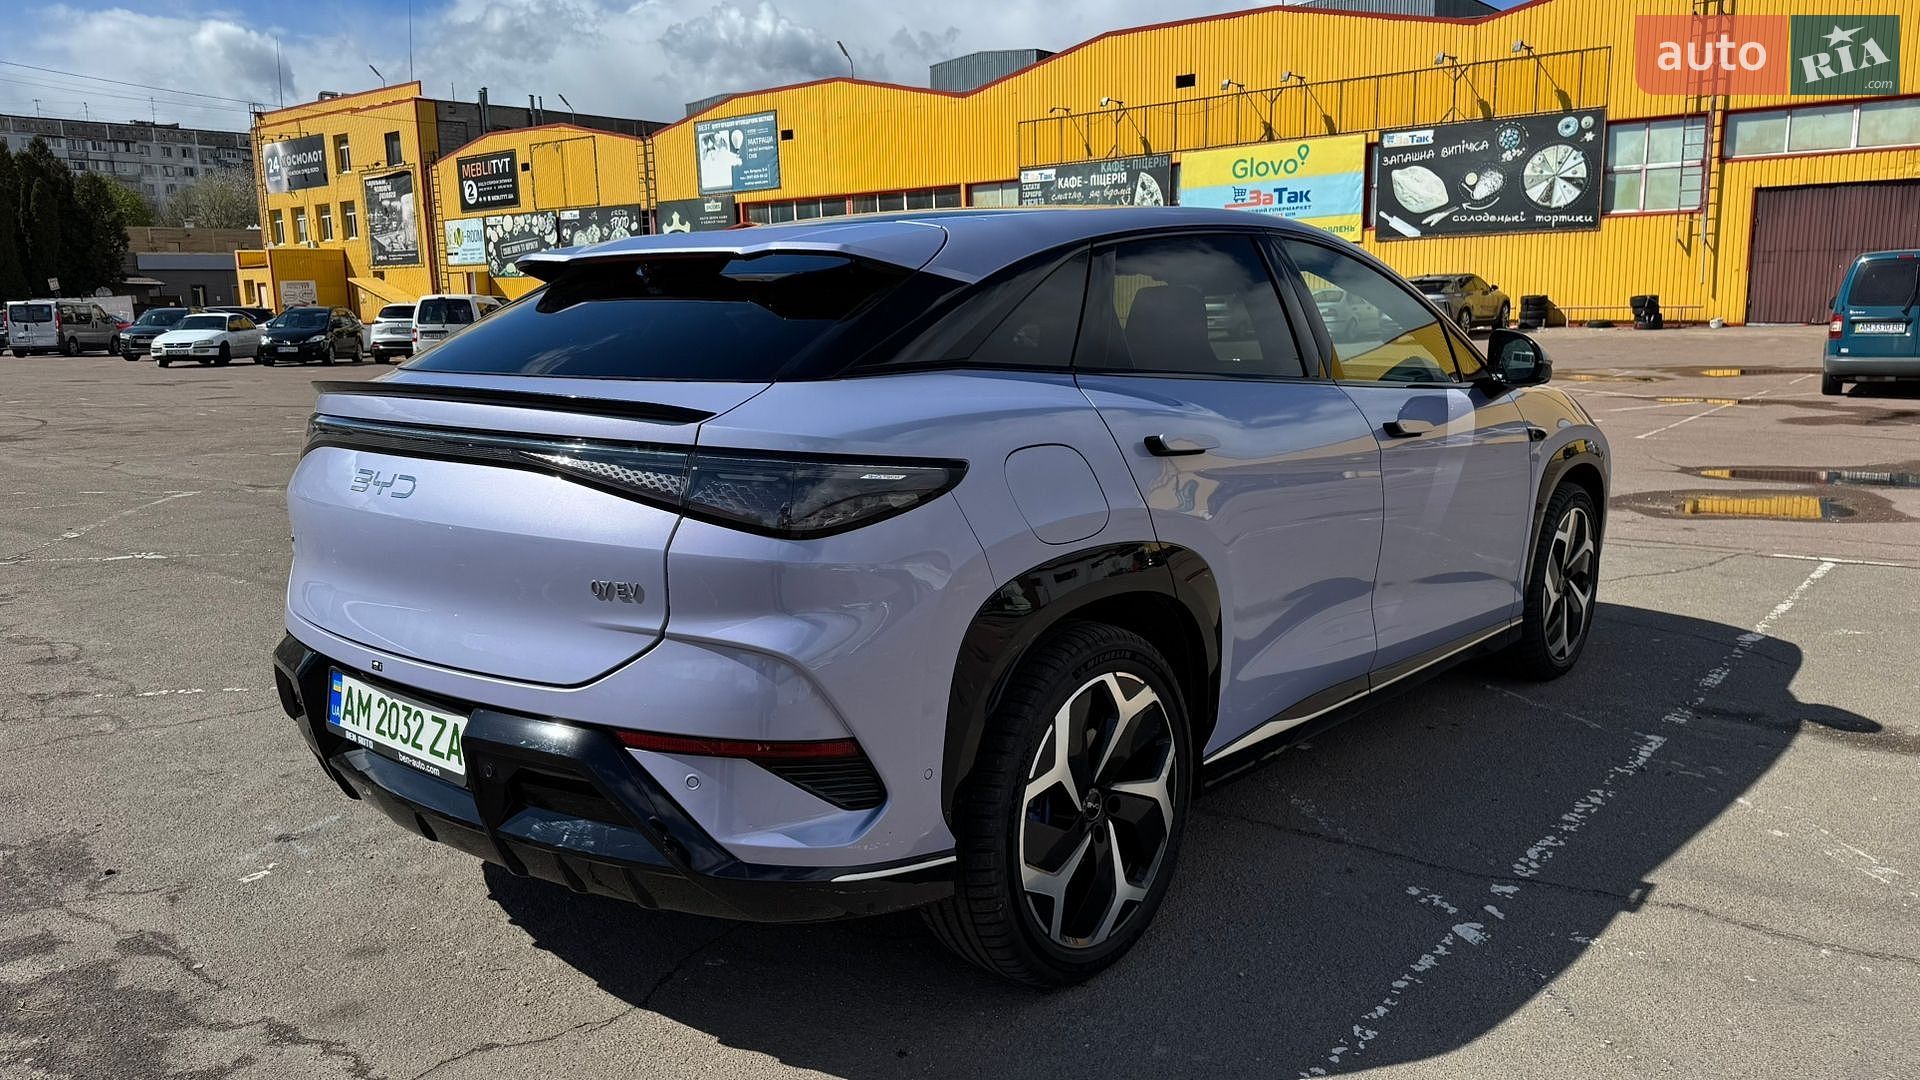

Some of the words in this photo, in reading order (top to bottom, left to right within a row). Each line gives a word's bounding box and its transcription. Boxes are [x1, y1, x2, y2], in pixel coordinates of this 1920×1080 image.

[1382, 150, 1435, 166] ЗАПАШНА
[1440, 139, 1490, 158] ВИПІЧКА
[267, 156, 280, 174] 24
[1100, 161, 1125, 173] КАФЕ
[1132, 155, 1169, 170] ПІЦЕРІЯ
[1231, 157, 1299, 179] Glovo
[1057, 175, 1083, 189] КАФЕ
[1090, 171, 1127, 187] ПІЦЕРІЯ
[467, 183, 475, 198] 2
[1249, 186, 1312, 206] ЗаТак
[1452, 211, 1526, 223] солоденькі
[1535, 213, 1594, 228] тортики
[350, 468, 417, 499] BYD
[331, 705, 341, 717] UA
[342, 685, 373, 732] AM
[375, 697, 425, 752] 2032
[429, 714, 464, 767] ZA
[398, 751, 441, 778] ben-auto.com
